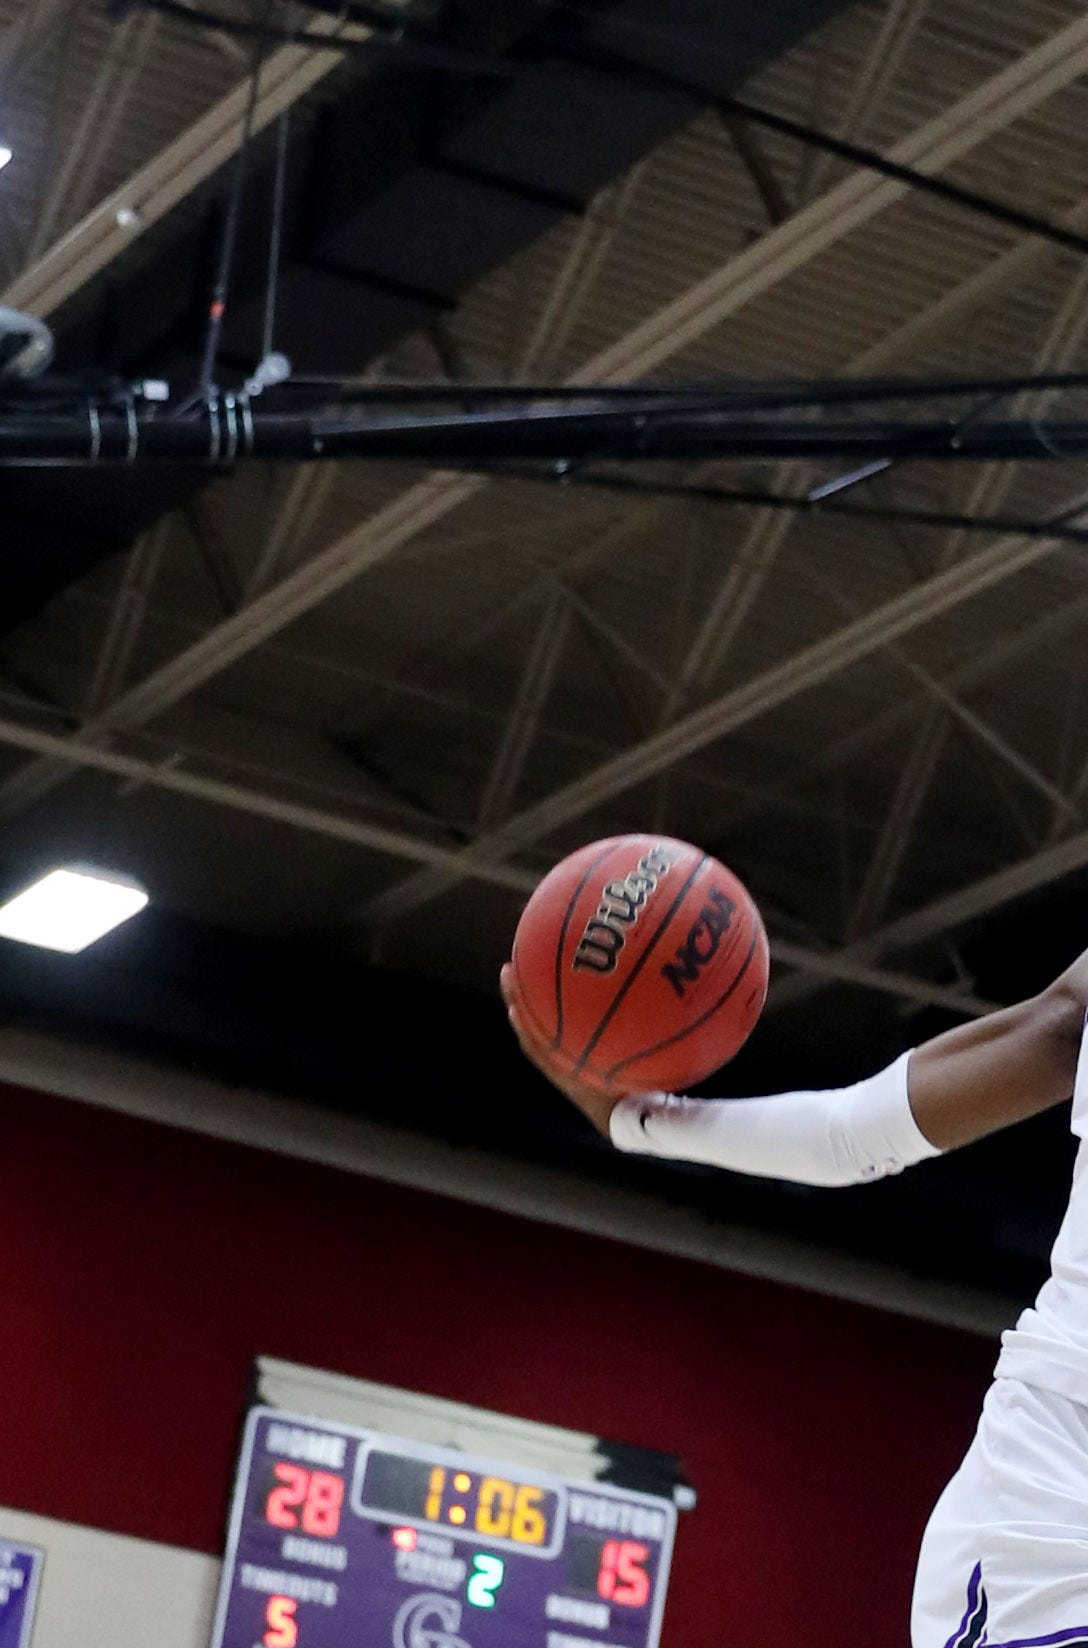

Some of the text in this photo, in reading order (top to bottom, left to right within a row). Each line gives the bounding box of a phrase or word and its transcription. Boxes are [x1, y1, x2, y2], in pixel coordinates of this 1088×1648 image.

[660, 886, 737, 998] NCAA
[265, 1462, 345, 1538] 28
[425, 1466, 547, 1545] 1:06
[467, 1552, 505, 1609] 2
[596, 1539, 651, 1608] 15
